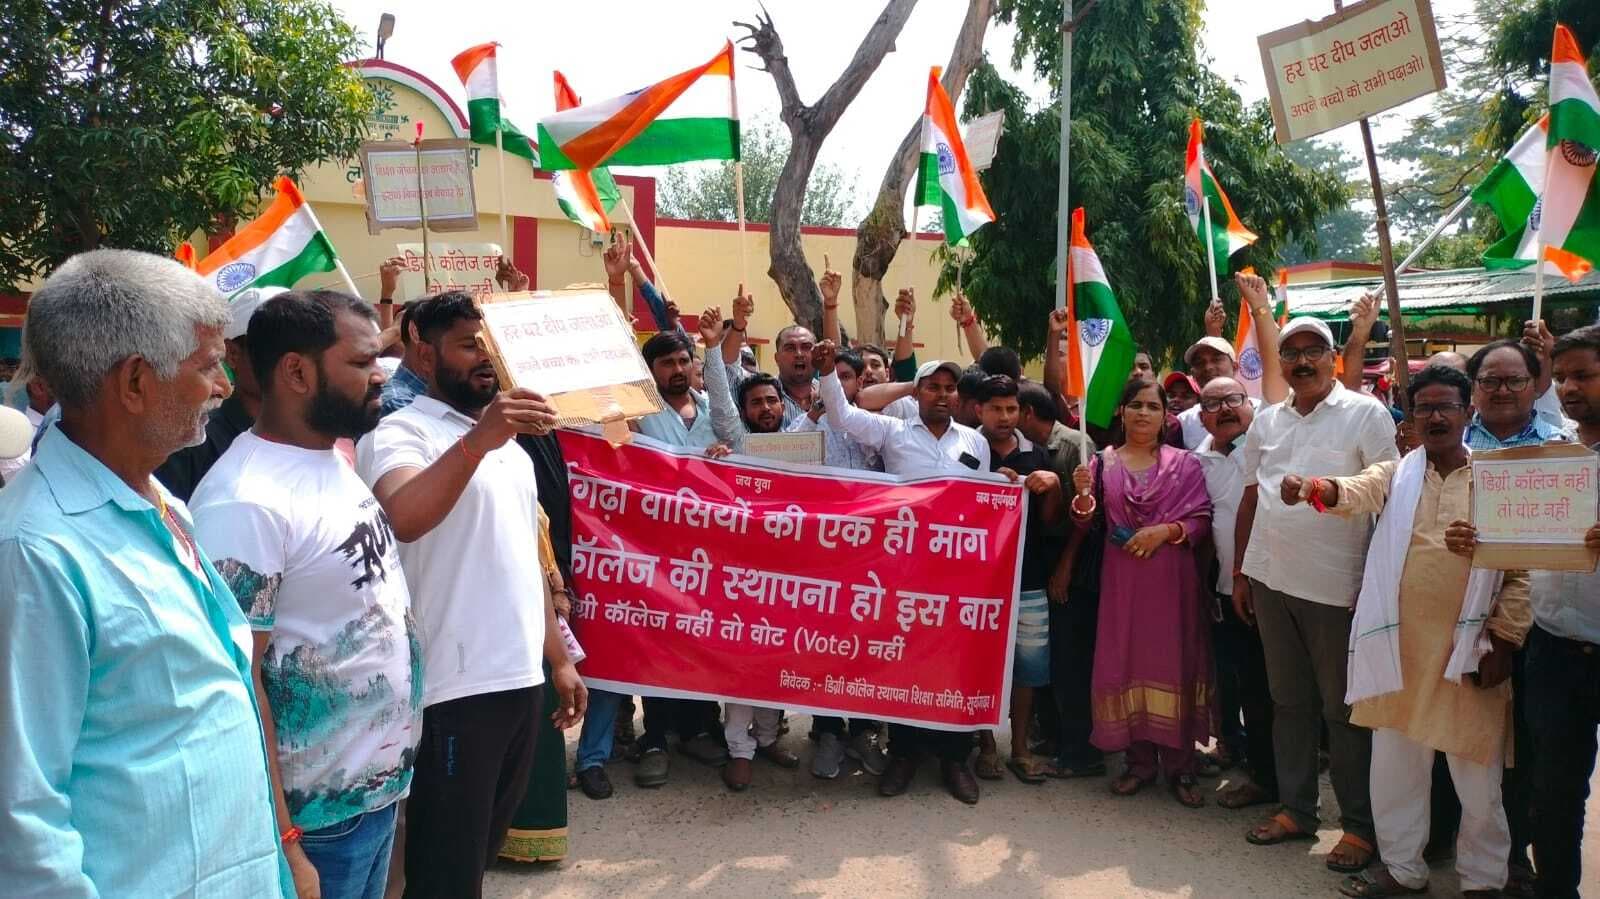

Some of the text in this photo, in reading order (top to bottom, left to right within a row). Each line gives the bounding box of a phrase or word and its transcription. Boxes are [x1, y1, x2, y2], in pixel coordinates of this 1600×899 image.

[1283, 11, 1411, 83] हर घर दीप जलाओ
[1290, 96, 1317, 118] अपने
[1346, 80, 1362, 98] को
[1363, 70, 1386, 93] सभी
[439, 249, 480, 271] कॉलेज
[735, 474, 772, 494] जय युवा
[975, 491, 990, 505] जय
[1480, 469, 1510, 491] डिग्री
[1514, 468, 1559, 490] कॉलेज
[567, 461, 988, 561] गढ़ा वासियों की एक ही मांग
[1496, 496, 1512, 519] तो
[1516, 496, 1540, 519] वोट
[669, 548, 712, 596] की
[722, 564, 842, 615] स्थापना
[850, 571, 886, 622] हो
[896, 590, 949, 632] इस
[958, 596, 1004, 630] बार
[604, 600, 669, 631] कॉलेज
[675, 610, 714, 638] नहीं
[720, 612, 744, 641] तो
[750, 617, 786, 647] वोट
[793, 626, 860, 660] (Vote)
[867, 636, 905, 661] नहीं
[780, 669, 811, 690] निवेदक
[824, 674, 844, 695] डिग्री
[846, 677, 875, 699] कॉलेज
[877, 686, 909, 704] स्थापना
[911, 684, 934, 706] शिक्षा
